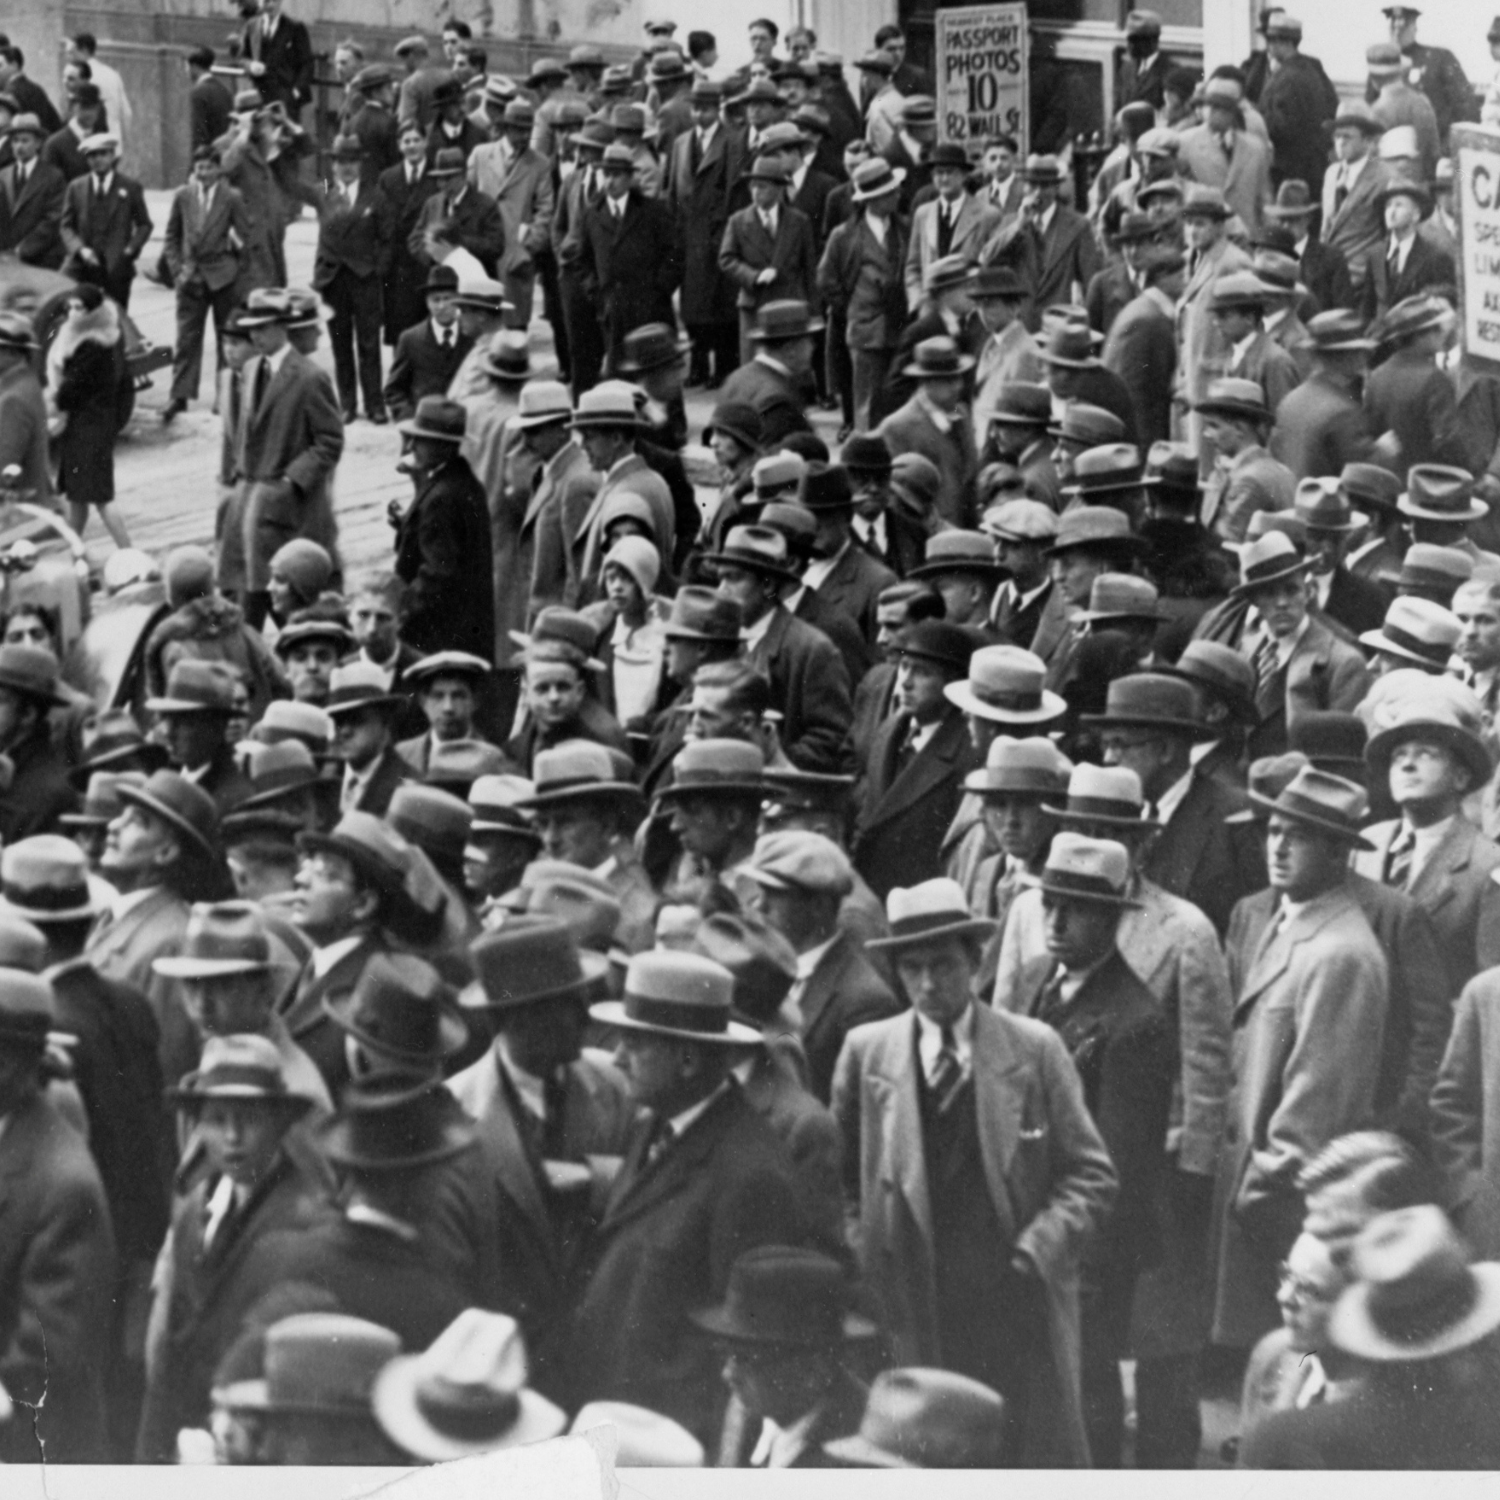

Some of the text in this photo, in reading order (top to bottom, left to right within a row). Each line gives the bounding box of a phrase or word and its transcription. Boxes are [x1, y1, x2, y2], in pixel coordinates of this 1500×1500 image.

[946, 25, 1019, 49] PASSPORT
[946, 49, 1020, 83] PHOTOS
[968, 72, 998, 113] 10
[968, 113, 1001, 138] WALL
